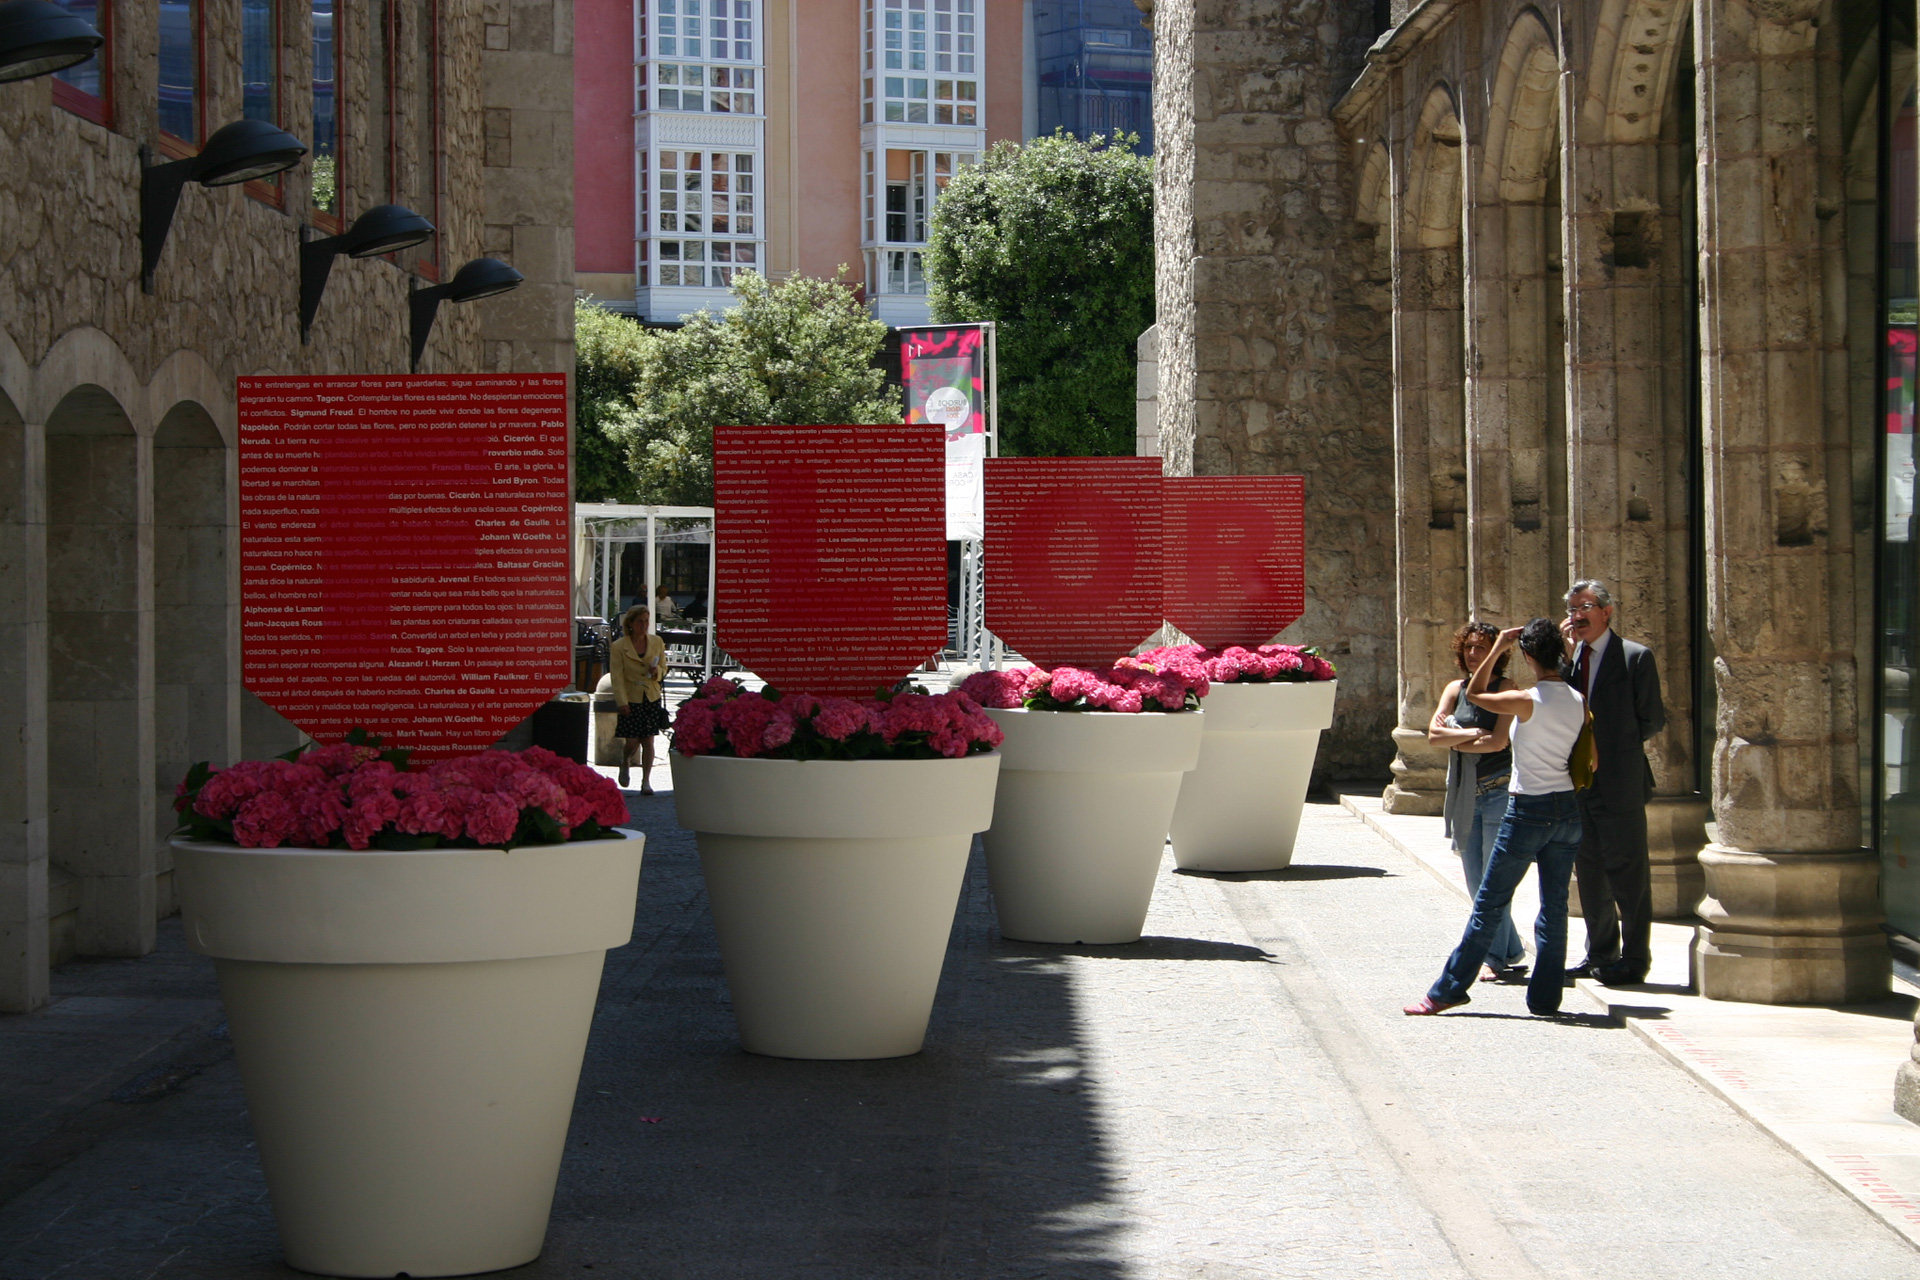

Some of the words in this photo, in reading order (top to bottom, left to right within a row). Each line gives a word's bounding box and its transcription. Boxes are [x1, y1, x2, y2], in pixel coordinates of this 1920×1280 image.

[452, 379, 472, 388] sigue
[291, 408, 326, 418] Sigmund
[413, 407, 436, 416] puede
[430, 421, 456, 430] podrán
[242, 465, 276, 474] podemos
[412, 603, 442, 613] siempre
[403, 618, 430, 627] plantas
[537, 644, 567, 654] grandes
[312, 688, 344, 698] después
[503, 715, 521, 723] pido
[445, 730, 461, 739] Hay
